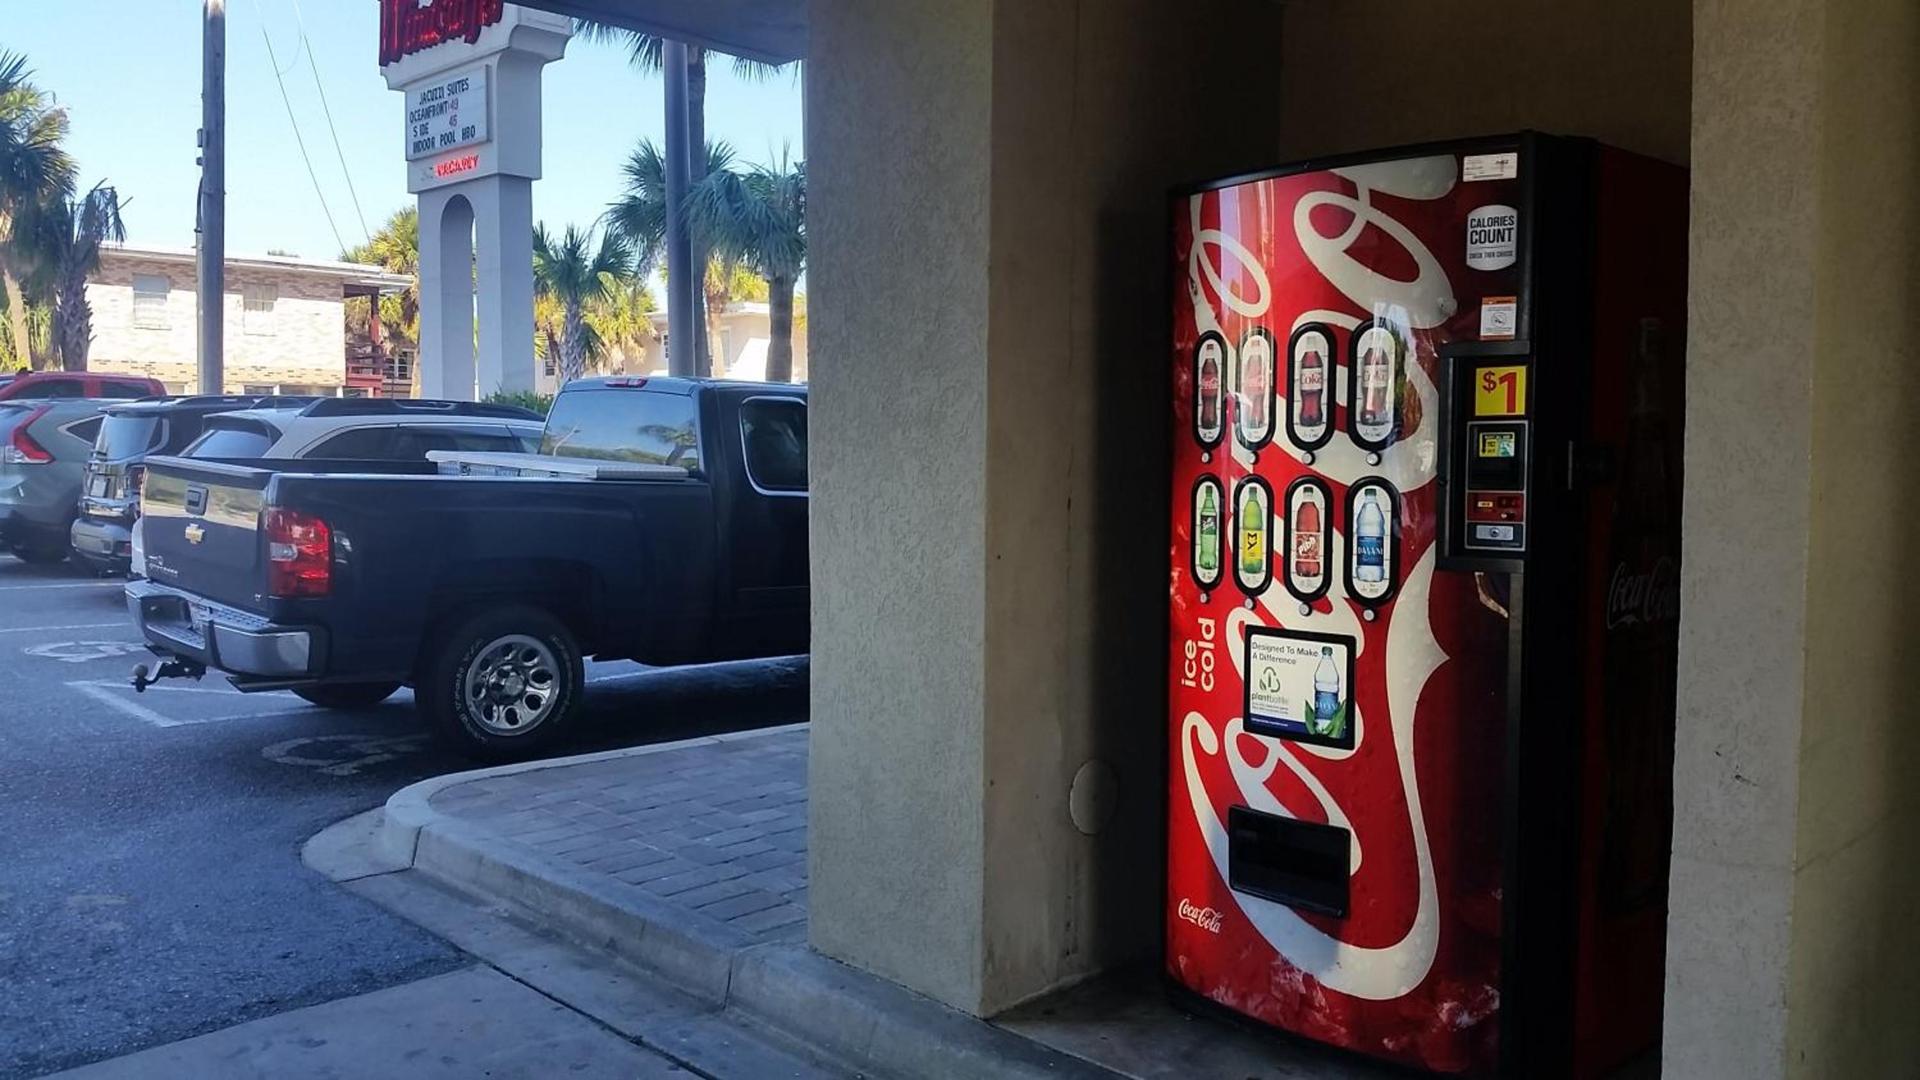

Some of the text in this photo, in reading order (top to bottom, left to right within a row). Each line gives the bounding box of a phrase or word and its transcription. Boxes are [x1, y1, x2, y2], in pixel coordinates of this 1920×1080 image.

[419, 78, 469, 105] JACUZZI SUITES
[409, 101, 448, 123] OCEANFRONT
[413, 137, 435, 154] INDOOR
[440, 131, 456, 147] POOL
[1470, 215, 1516, 229] CALORIES
[1470, 227, 1515, 245] COUNT
[1482, 370, 1518, 414] $1
[1197, 616, 1216, 692] cold
[1252, 641, 1319, 658] Designed To Make
[1252, 652, 1297, 665] A Difference
[1181, 639, 1197, 688] ice
